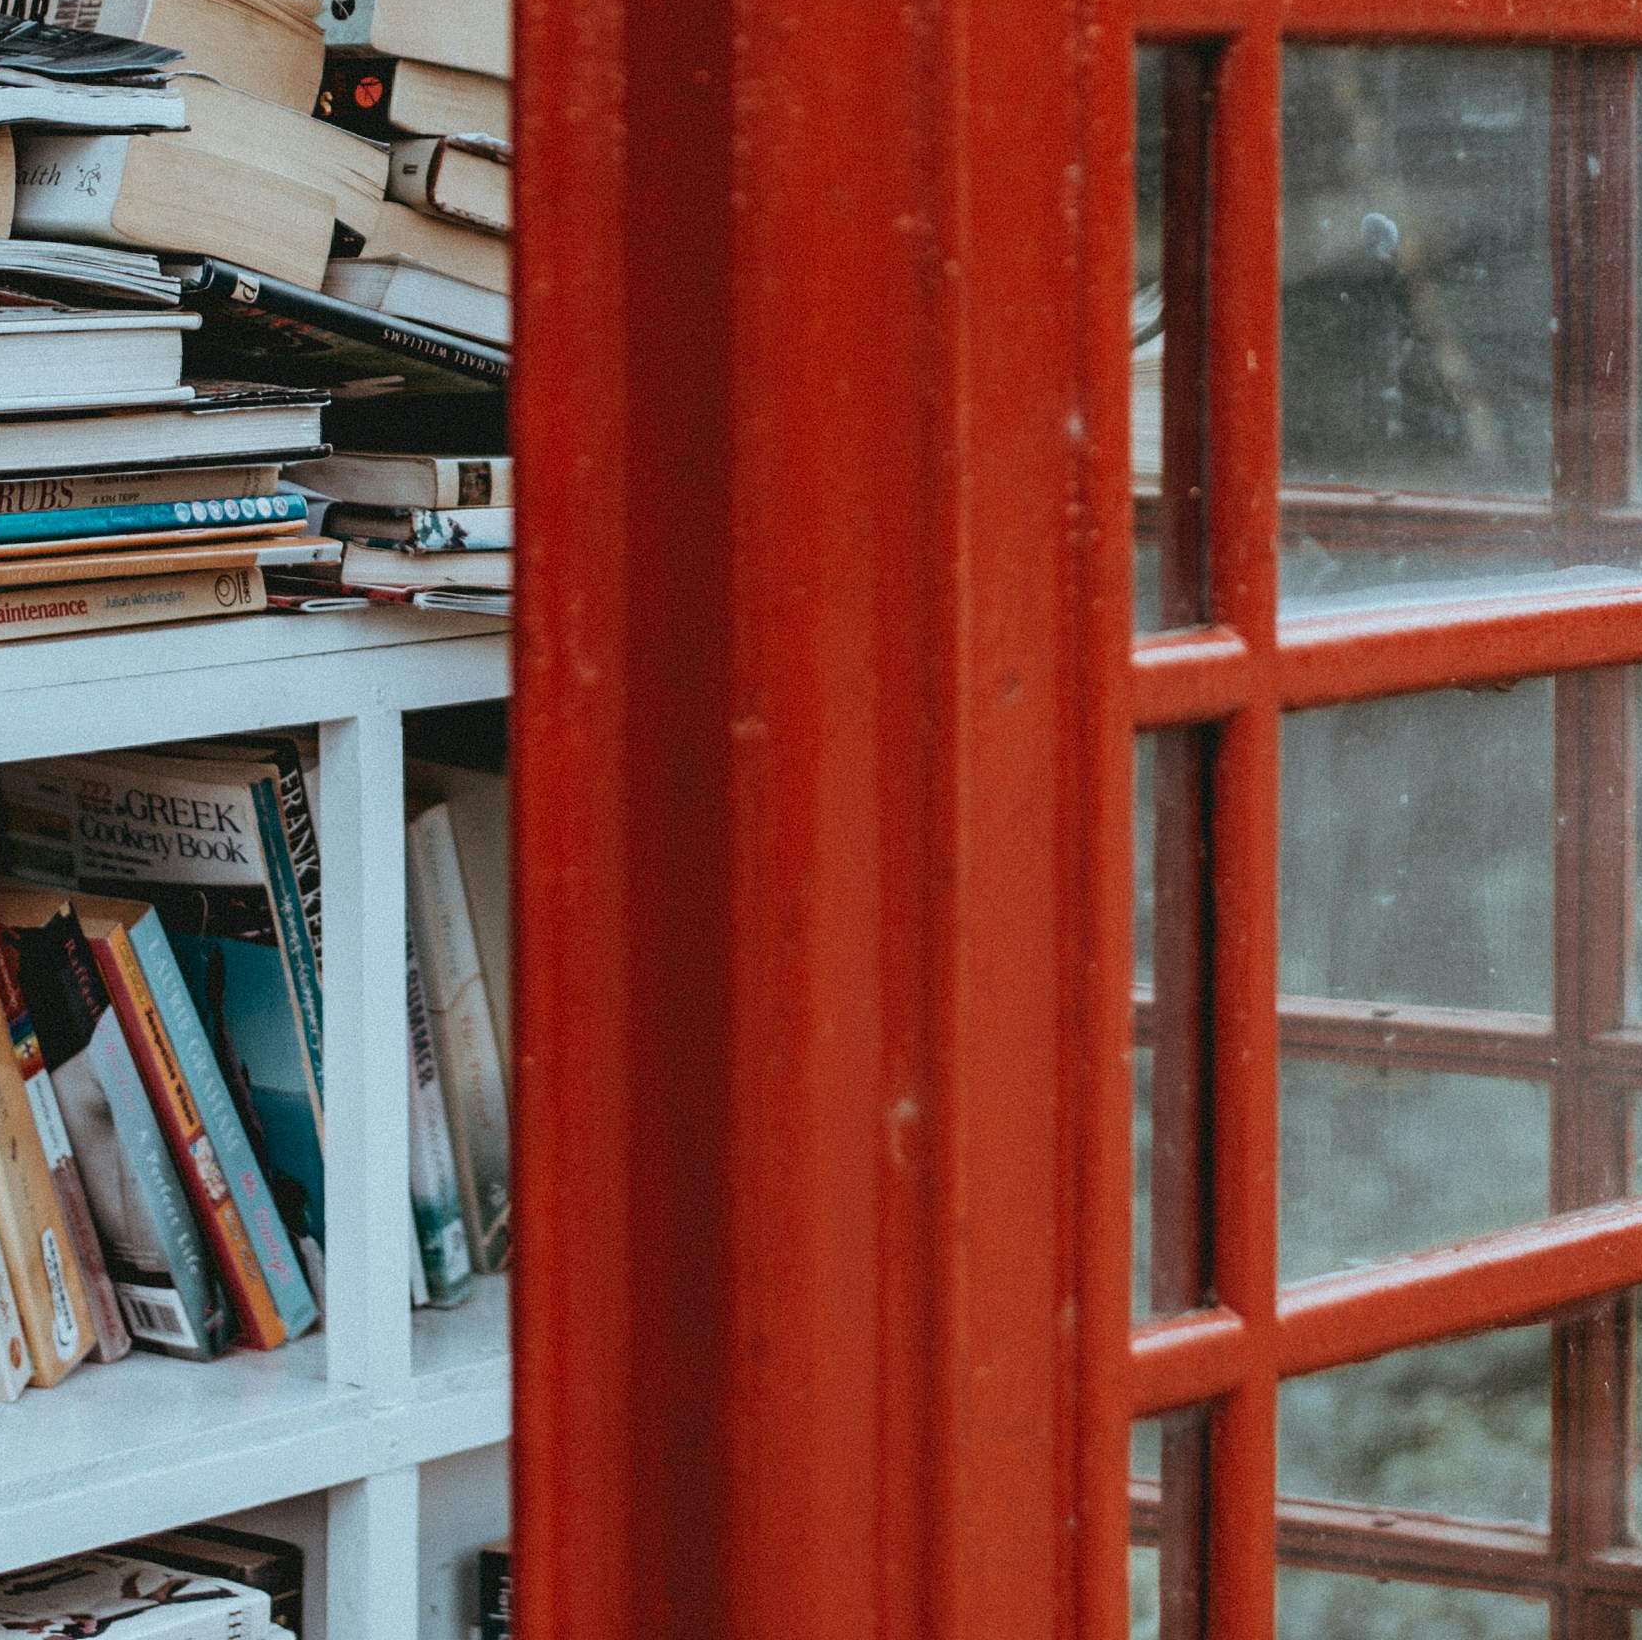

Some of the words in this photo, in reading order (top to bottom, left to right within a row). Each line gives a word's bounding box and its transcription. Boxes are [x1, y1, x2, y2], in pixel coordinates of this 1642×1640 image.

[381, 328, 448, 359] WILLIAMS
[118, 492, 140, 503] TRIPP
[103, 594, 132, 609] Julian
[124, 788, 242, 834] GREEK
[279, 769, 321, 881] FRANK
[78, 813, 174, 860] Cookery
[176, 832, 249, 864] Book
[147, 937, 192, 1033] LAURIE
[187, 1037, 241, 1153] GRAHAM
[146, 1148, 181, 1228] Perfect
[177, 1231, 199, 1276] Life
